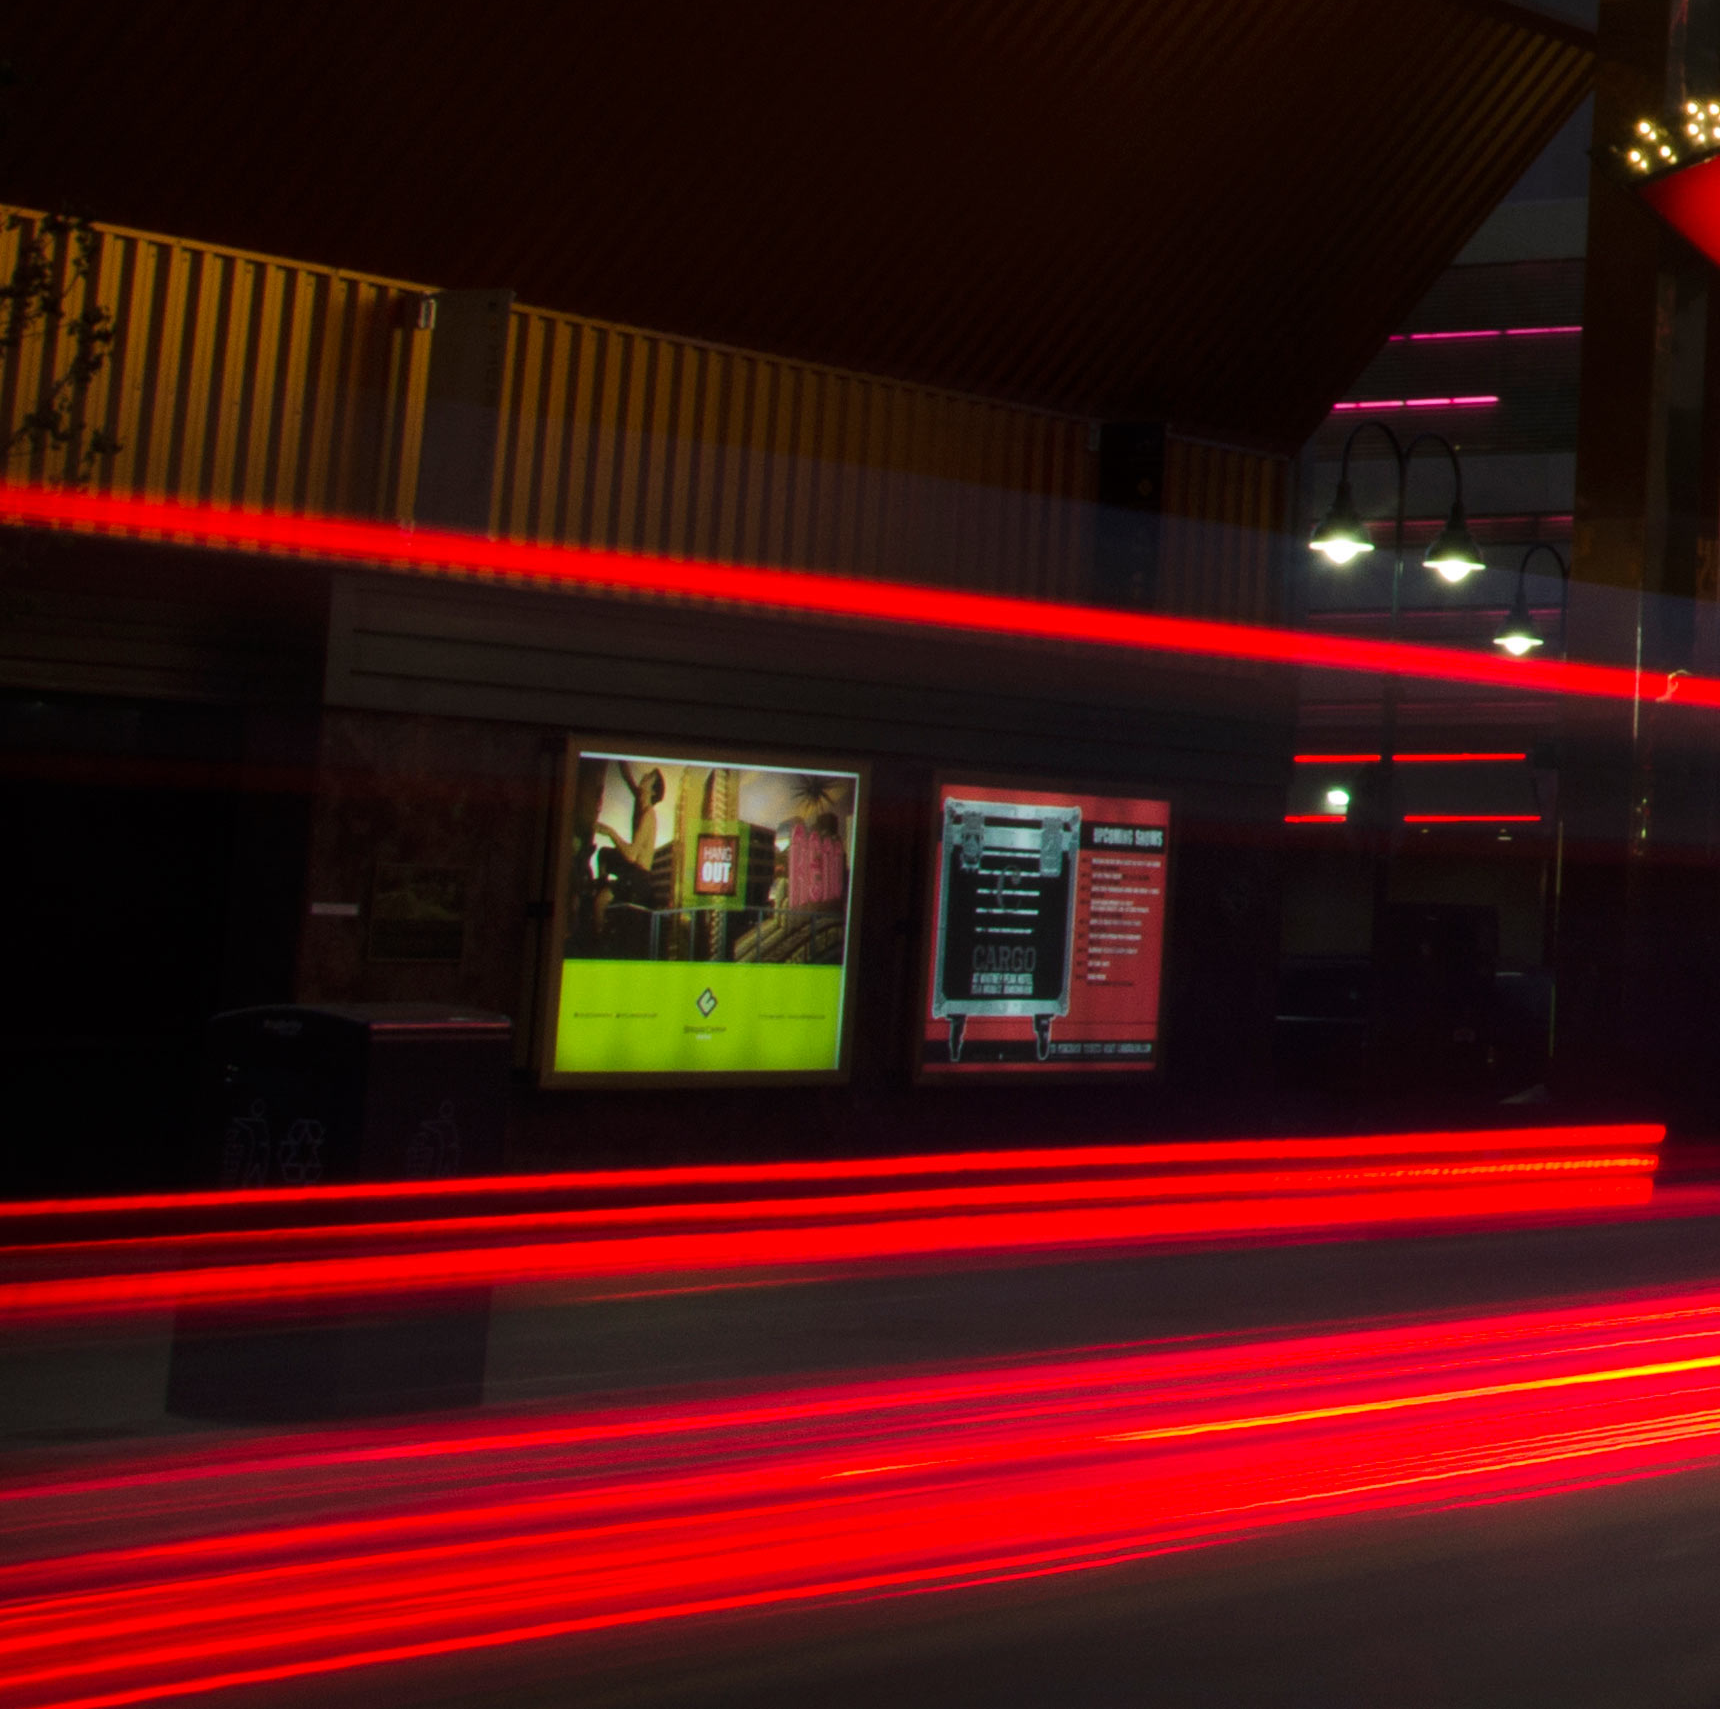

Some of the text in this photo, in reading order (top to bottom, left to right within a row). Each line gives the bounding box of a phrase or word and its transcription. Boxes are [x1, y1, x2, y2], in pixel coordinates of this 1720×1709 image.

[702, 846, 733, 861] HANG
[701, 861, 733, 884] OUT
[971, 944, 1038, 972] CARGO
